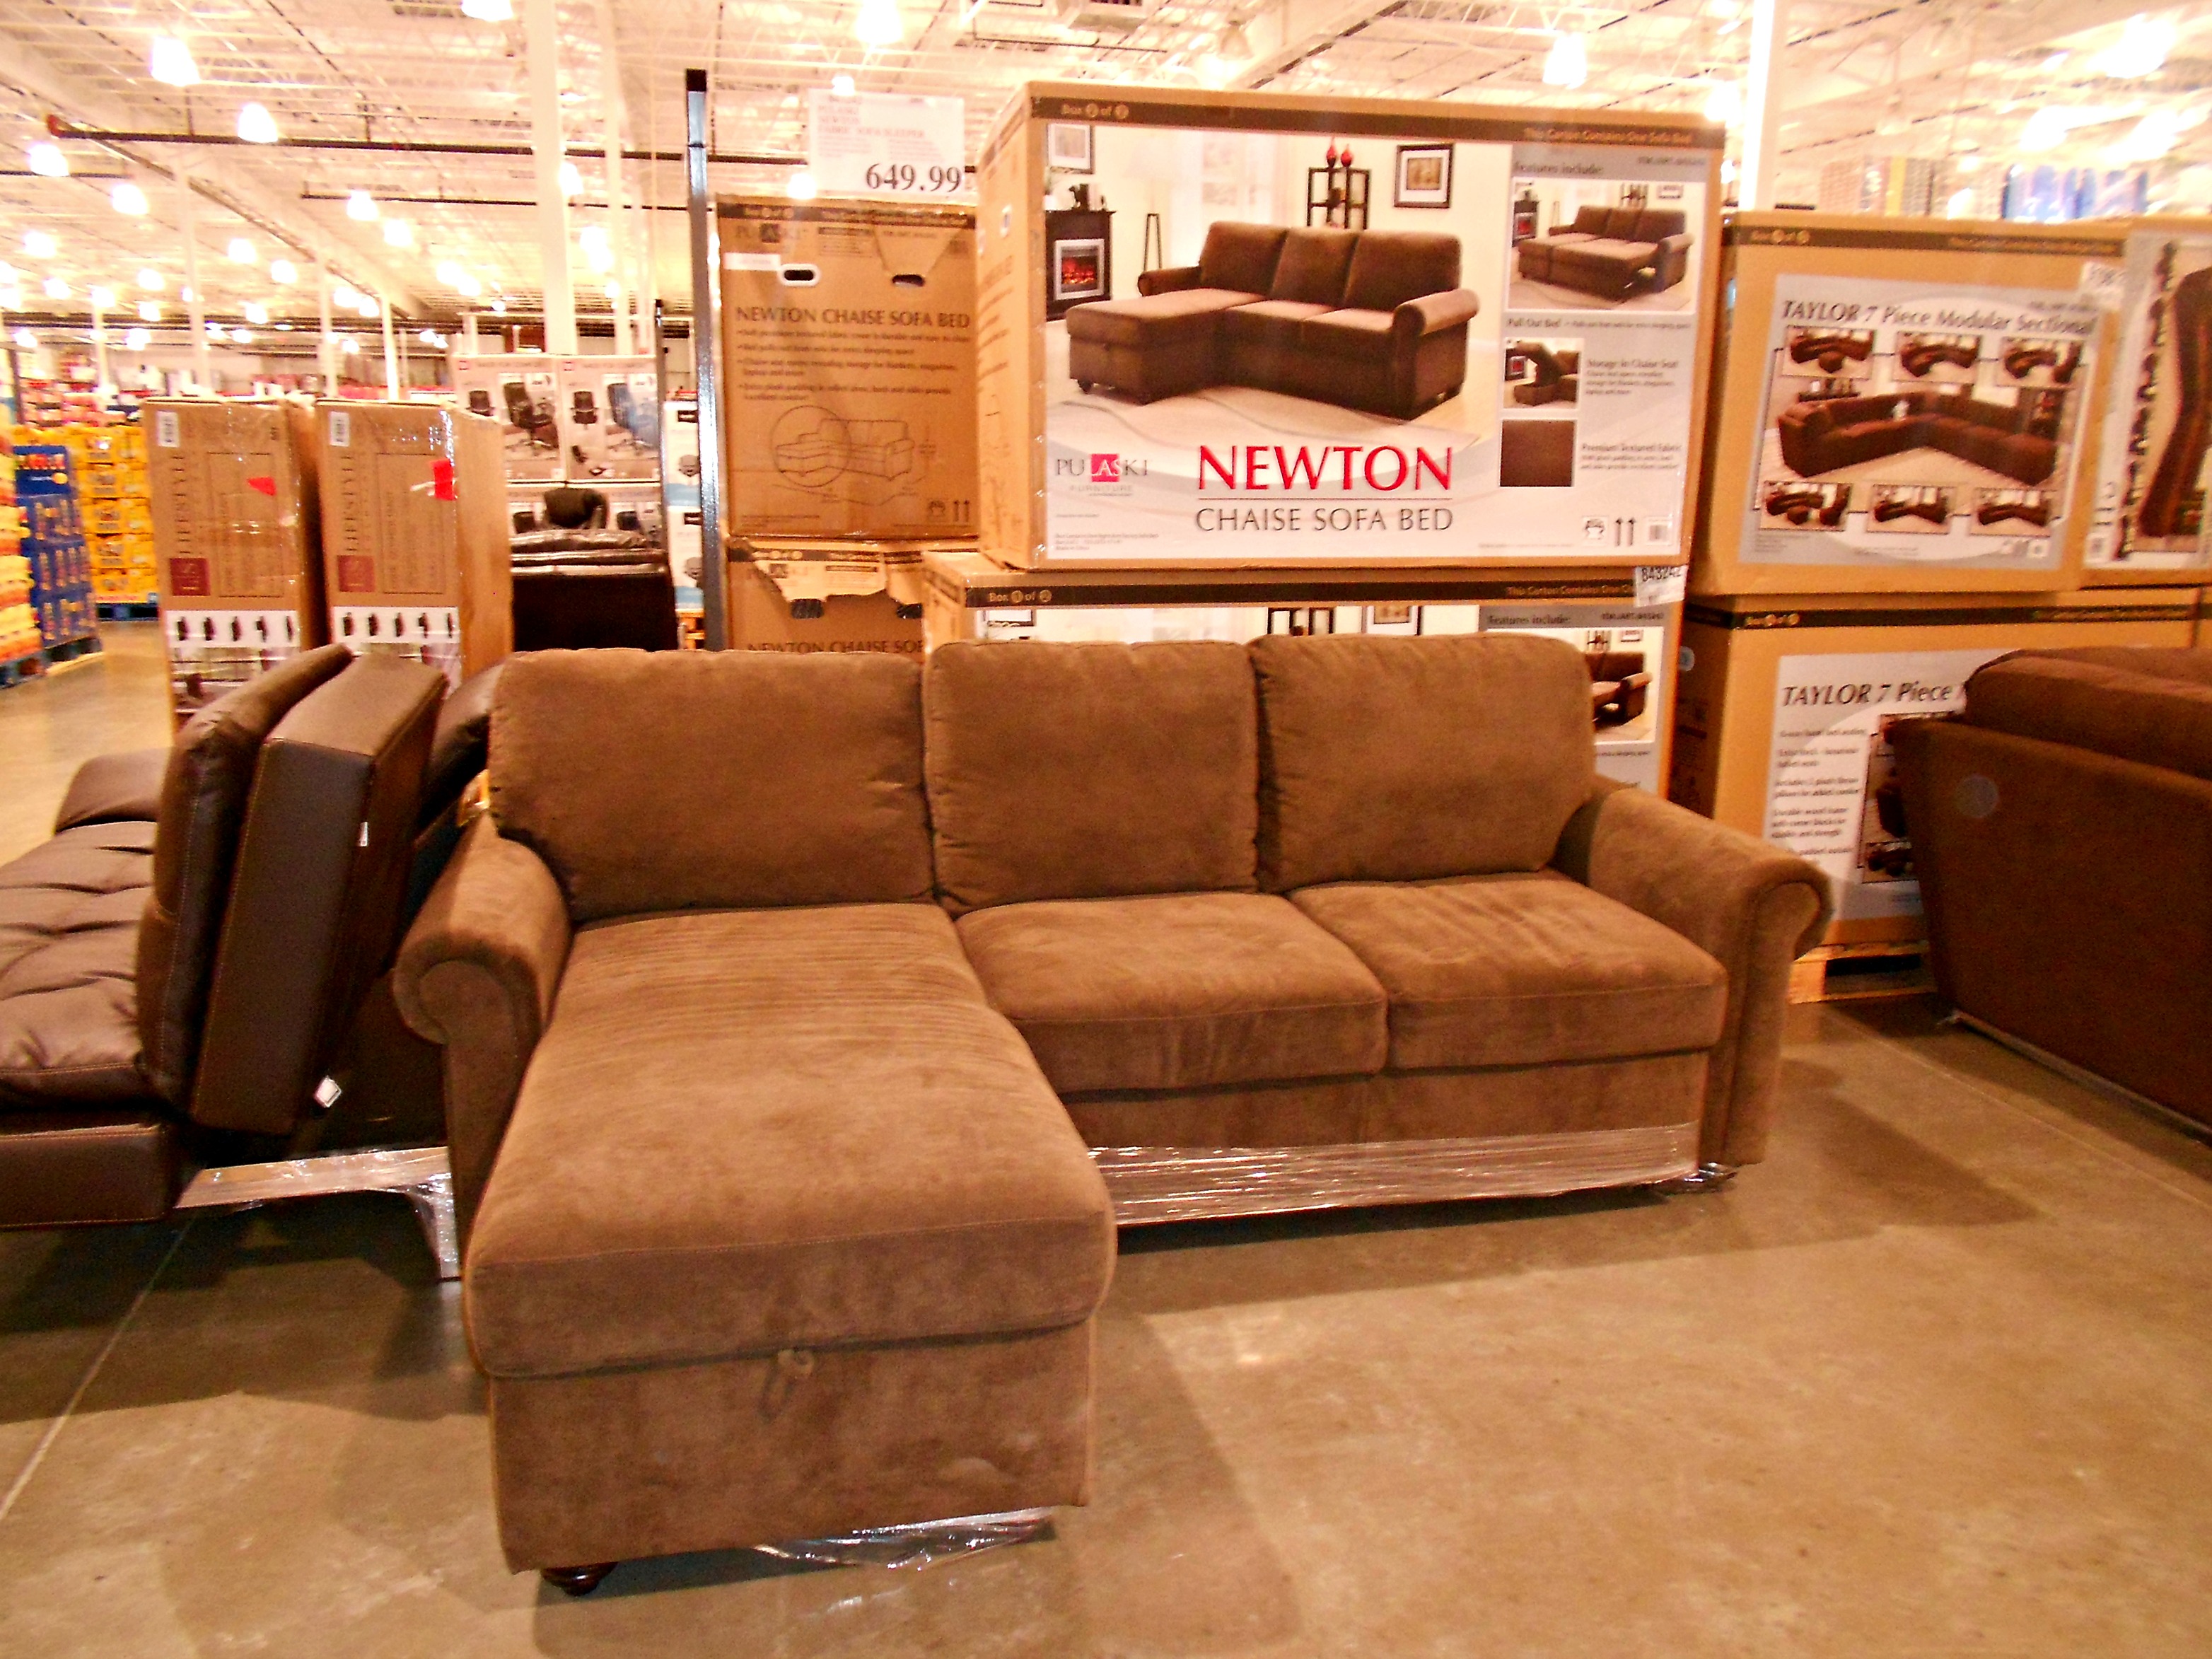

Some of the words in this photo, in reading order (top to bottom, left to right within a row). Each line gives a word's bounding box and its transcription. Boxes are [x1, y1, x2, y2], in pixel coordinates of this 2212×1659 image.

[866, 163, 961, 192] 649.99
[736, 306, 817, 322] NEWTON
[822, 308, 885, 325] CHAISE
[889, 311, 933, 327] SOFA
[938, 313, 972, 328] BED
[1783, 300, 1861, 322] TAYLOR
[1864, 305, 1878, 322] 7
[1881, 305, 1931, 325] Piece
[1056, 458, 1148, 477] PULASKI
[1199, 445, 1453, 491] NEWTON
[1196, 507, 1302, 532] CHAISE
[1314, 507, 1387, 532] SOFA
[1399, 508, 1454, 532] BED
[989, 592, 1008, 603] Box
[894, 639, 924, 653] SOF
[1782, 683, 1873, 706] TAYLOR
[1878, 683, 1892, 703] 7
[1895, 680, 1953, 704] Piece
